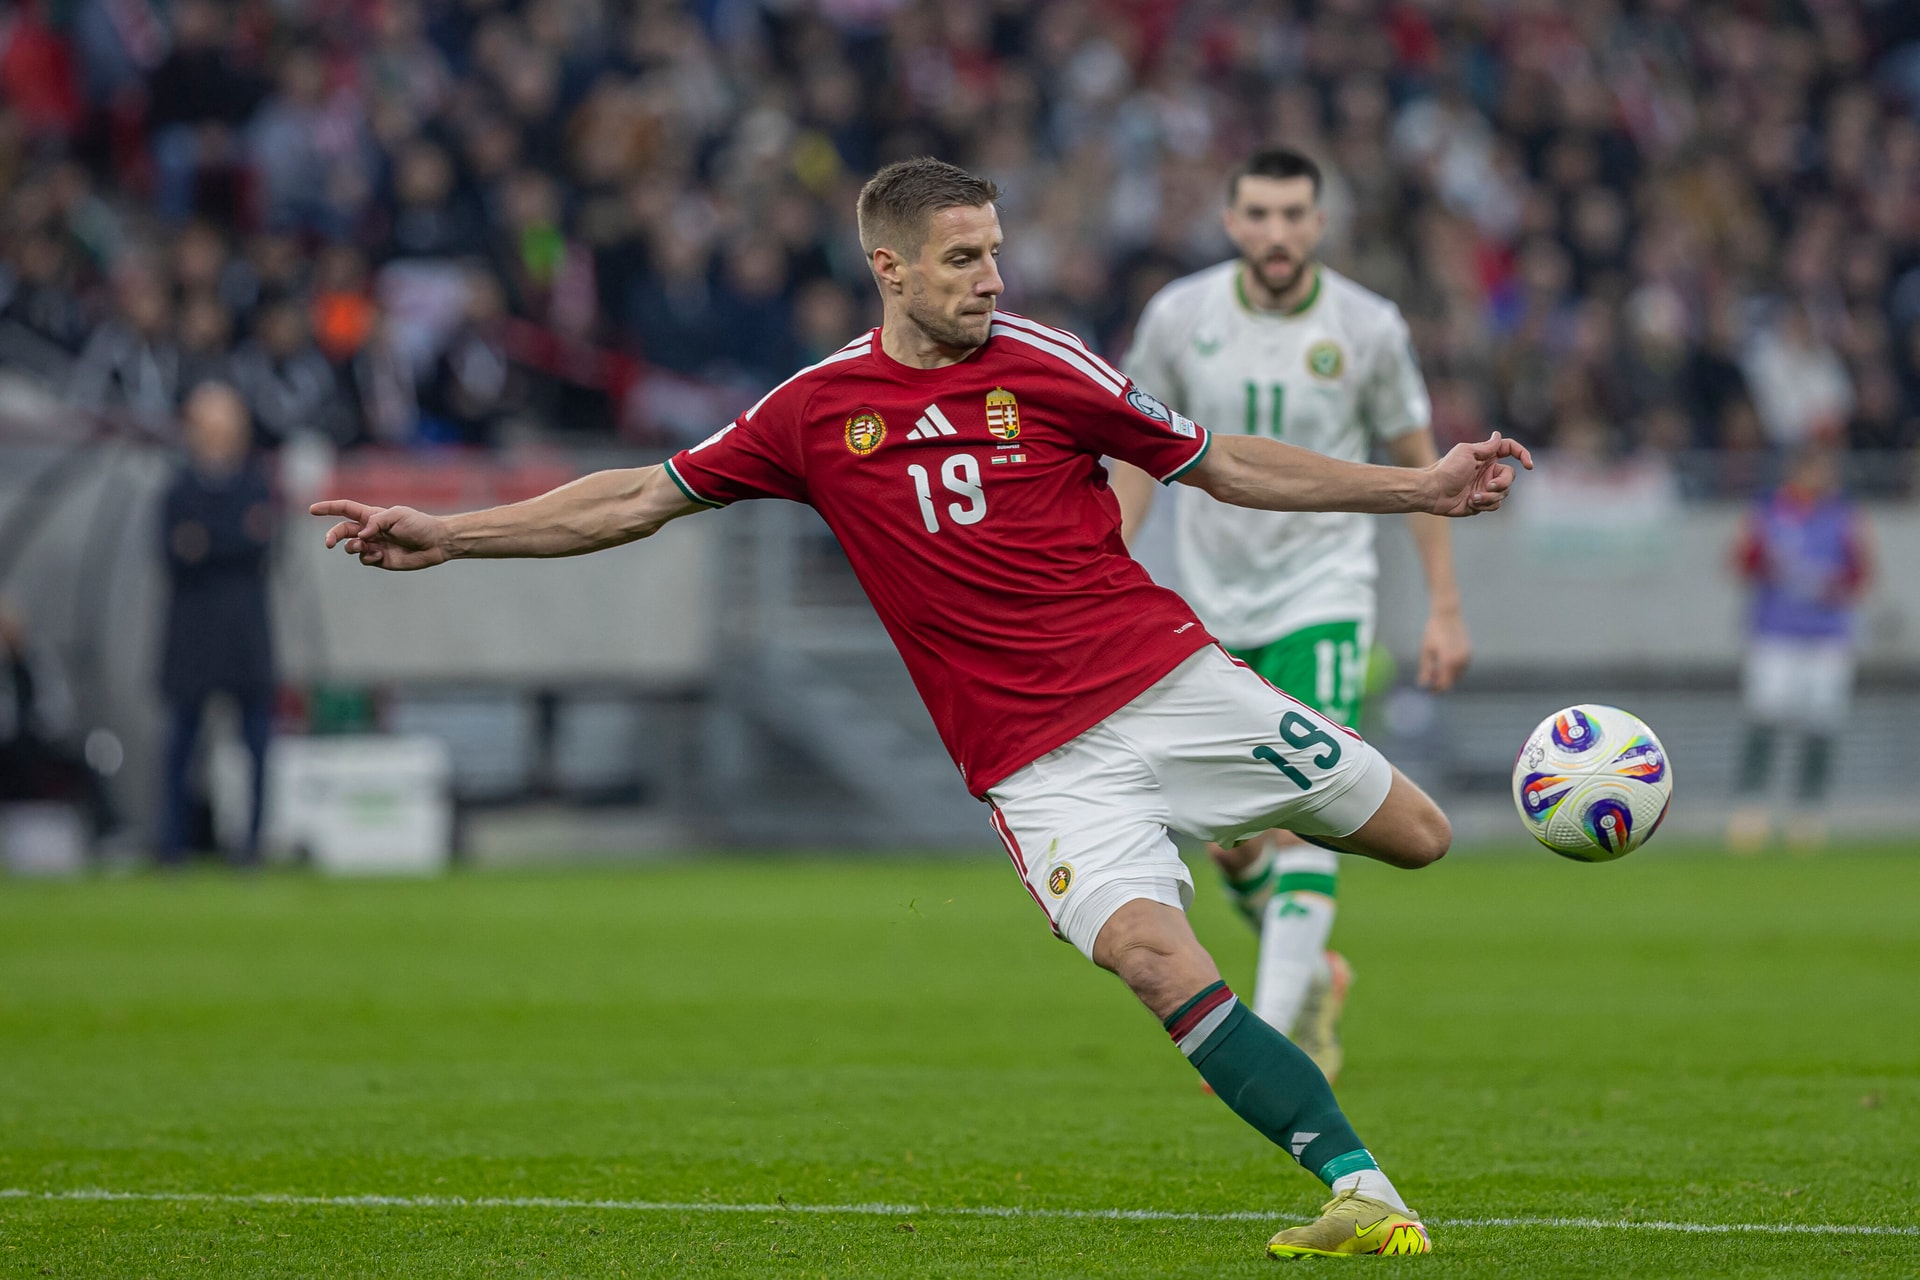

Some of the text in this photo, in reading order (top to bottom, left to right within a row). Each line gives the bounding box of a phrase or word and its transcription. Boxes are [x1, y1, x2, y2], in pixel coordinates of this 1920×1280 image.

[1245, 381, 1283, 436] 11
[907, 453, 987, 534] 19
[1252, 711, 1341, 790] 19
